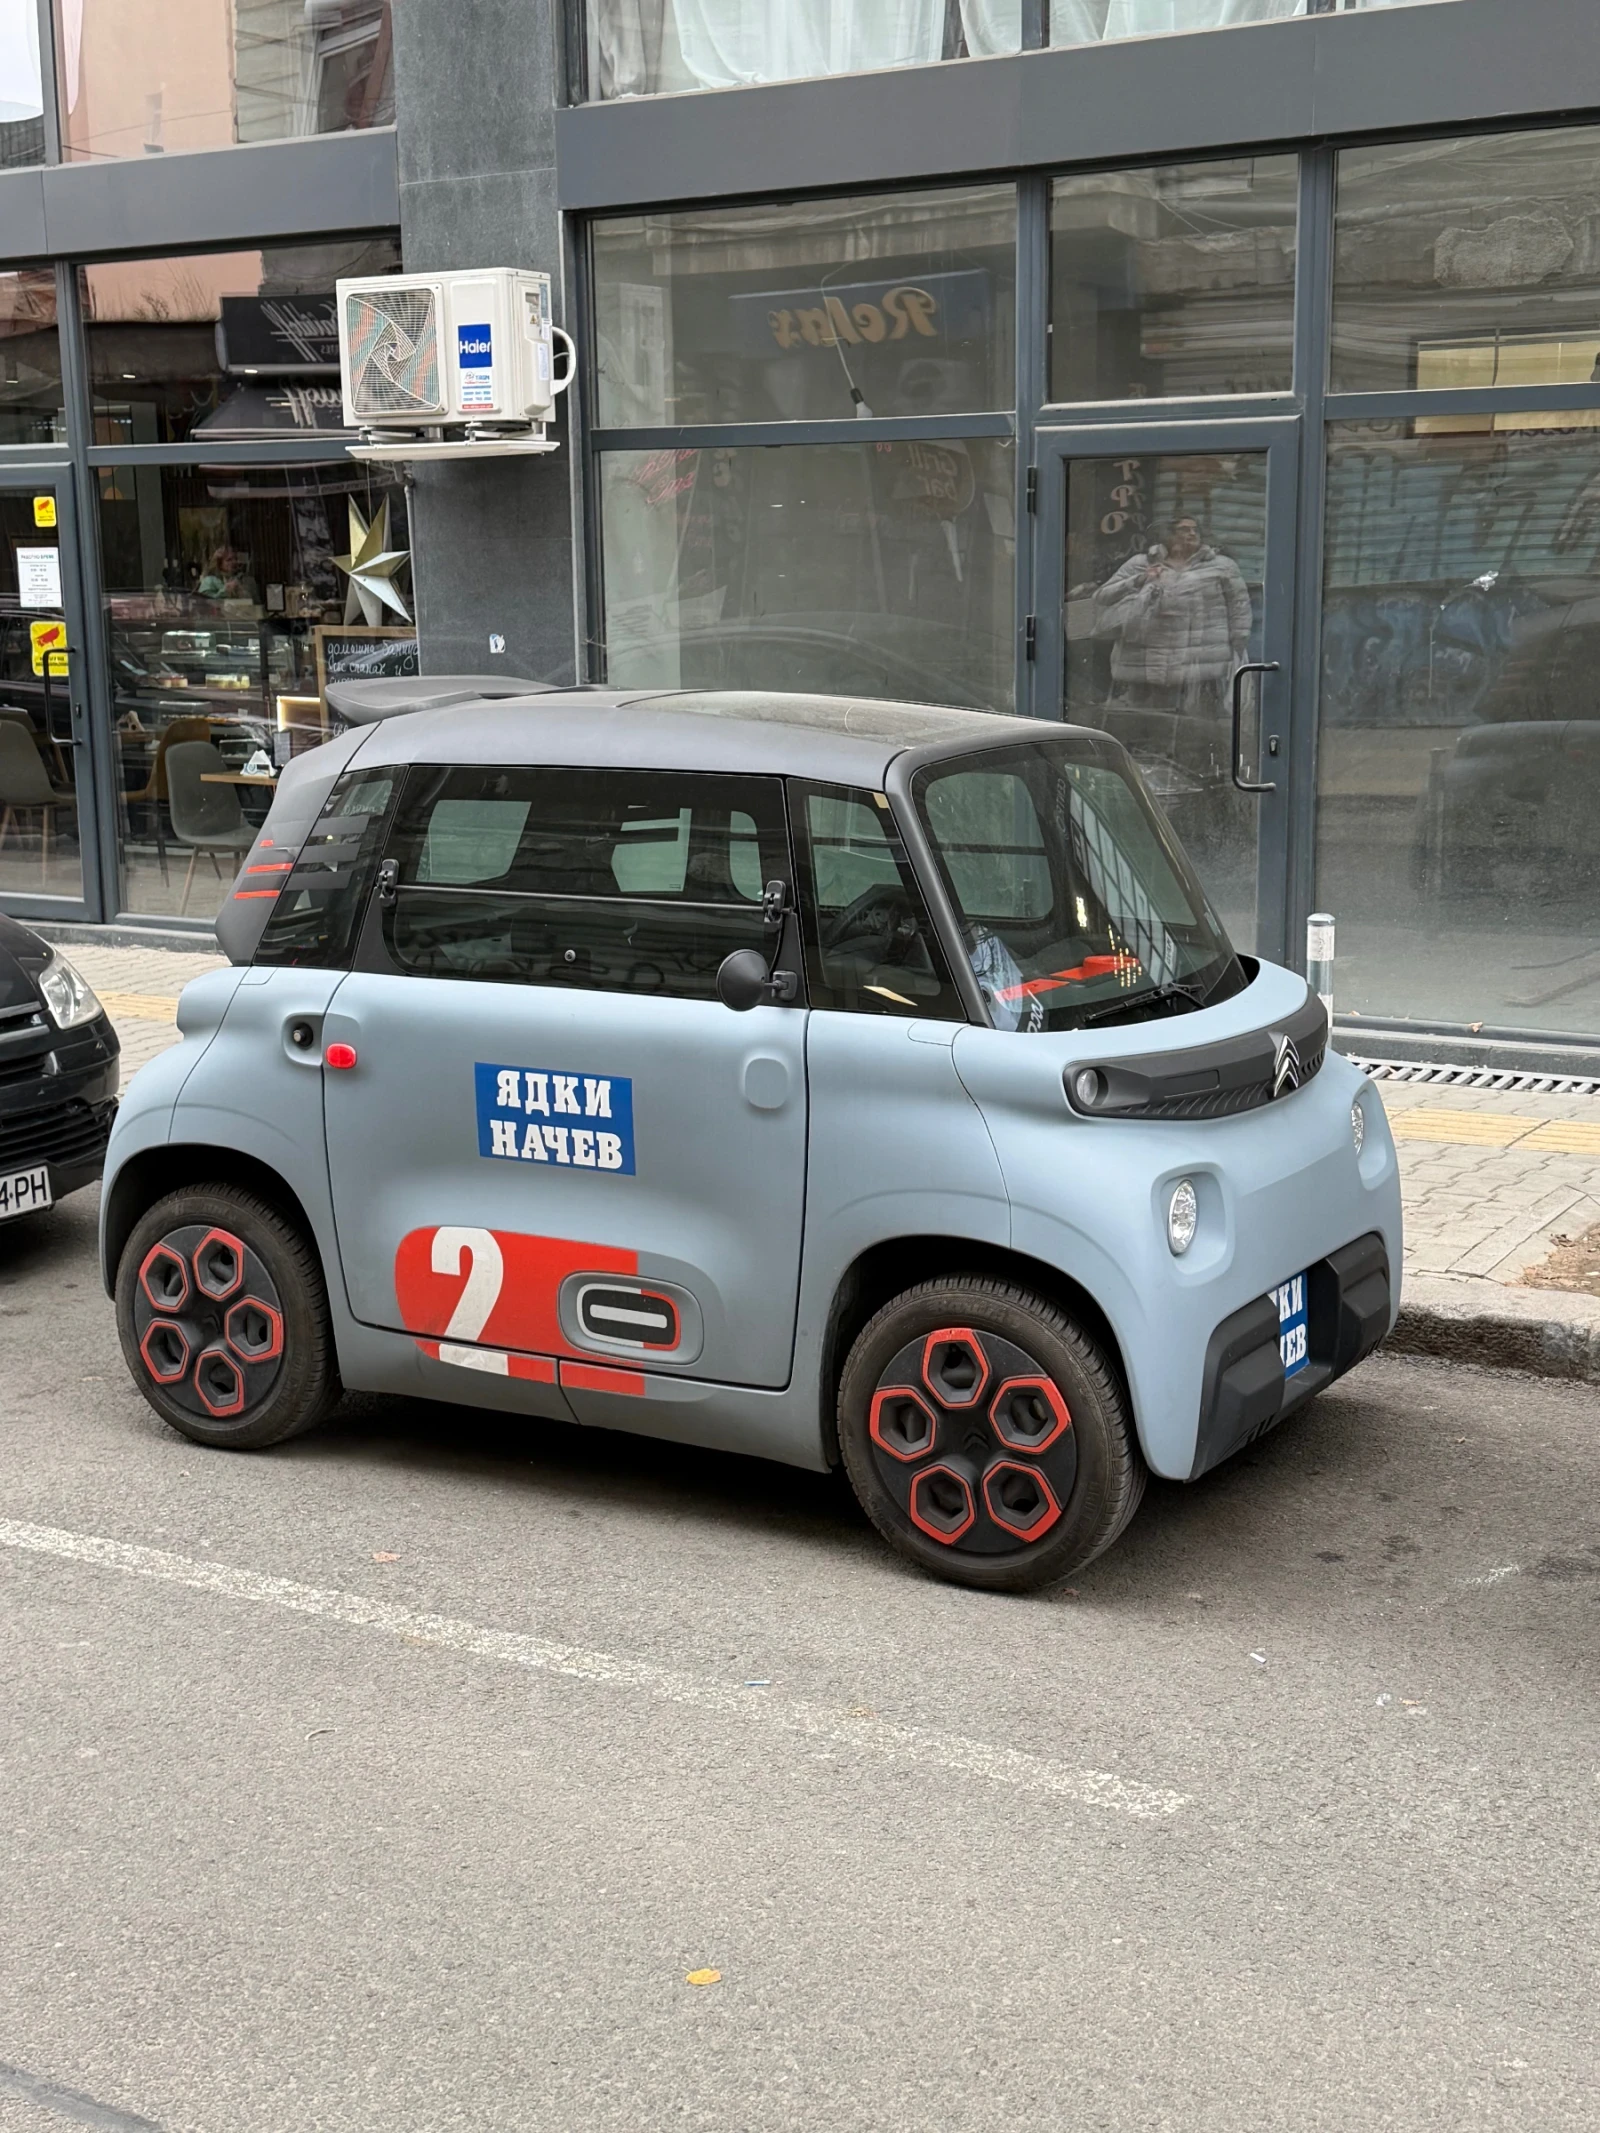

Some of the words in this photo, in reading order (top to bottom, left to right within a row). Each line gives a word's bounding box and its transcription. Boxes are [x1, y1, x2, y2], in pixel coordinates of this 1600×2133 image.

[460, 339, 491, 354] Haier
[497, 1070, 612, 1118] ЯДКИ
[490, 1120, 622, 1169] НАЧЕВ
